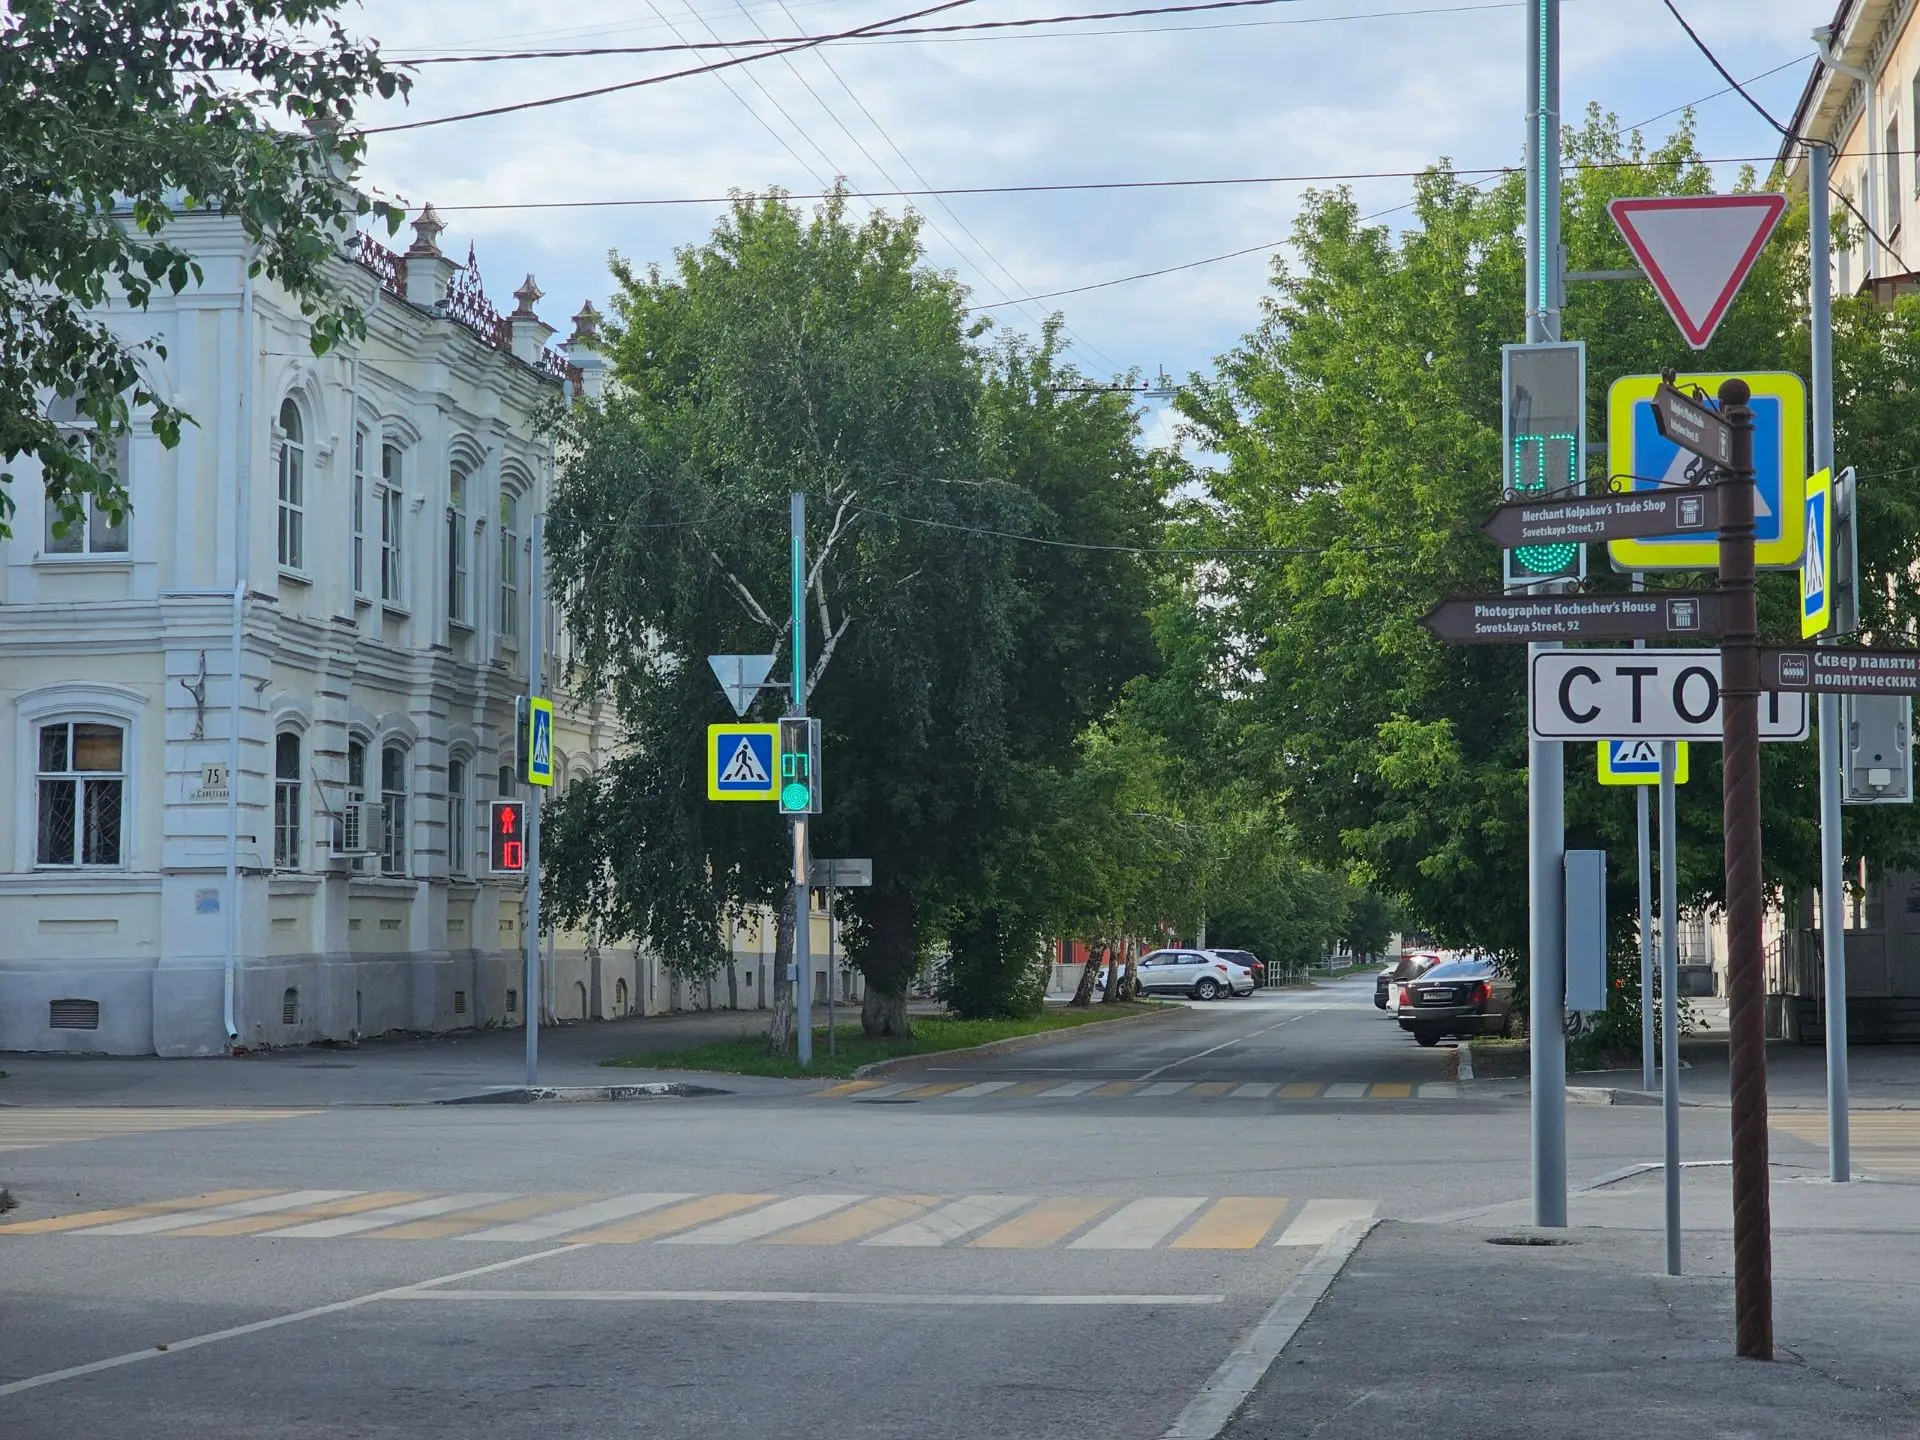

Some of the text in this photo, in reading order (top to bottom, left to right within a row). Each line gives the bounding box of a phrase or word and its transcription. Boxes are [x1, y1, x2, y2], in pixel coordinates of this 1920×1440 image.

[1522, 507, 1564, 523] Merchant
[1616, 502, 1642, 514] Trade
[1643, 499, 1666, 514] Shop
[1522, 521, 1605, 539] Sovetskaya Street, 73
[1474, 603, 1552, 620] Photographer
[1622, 600, 1657, 613] House
[1475, 619, 1580, 635] Sovetskaya Street, 92
[1814, 651, 1857, 671] Сквер
[1860, 656, 1915, 670] памяти
[1814, 673, 1917, 688] политических
[208, 768, 220, 784] 75
